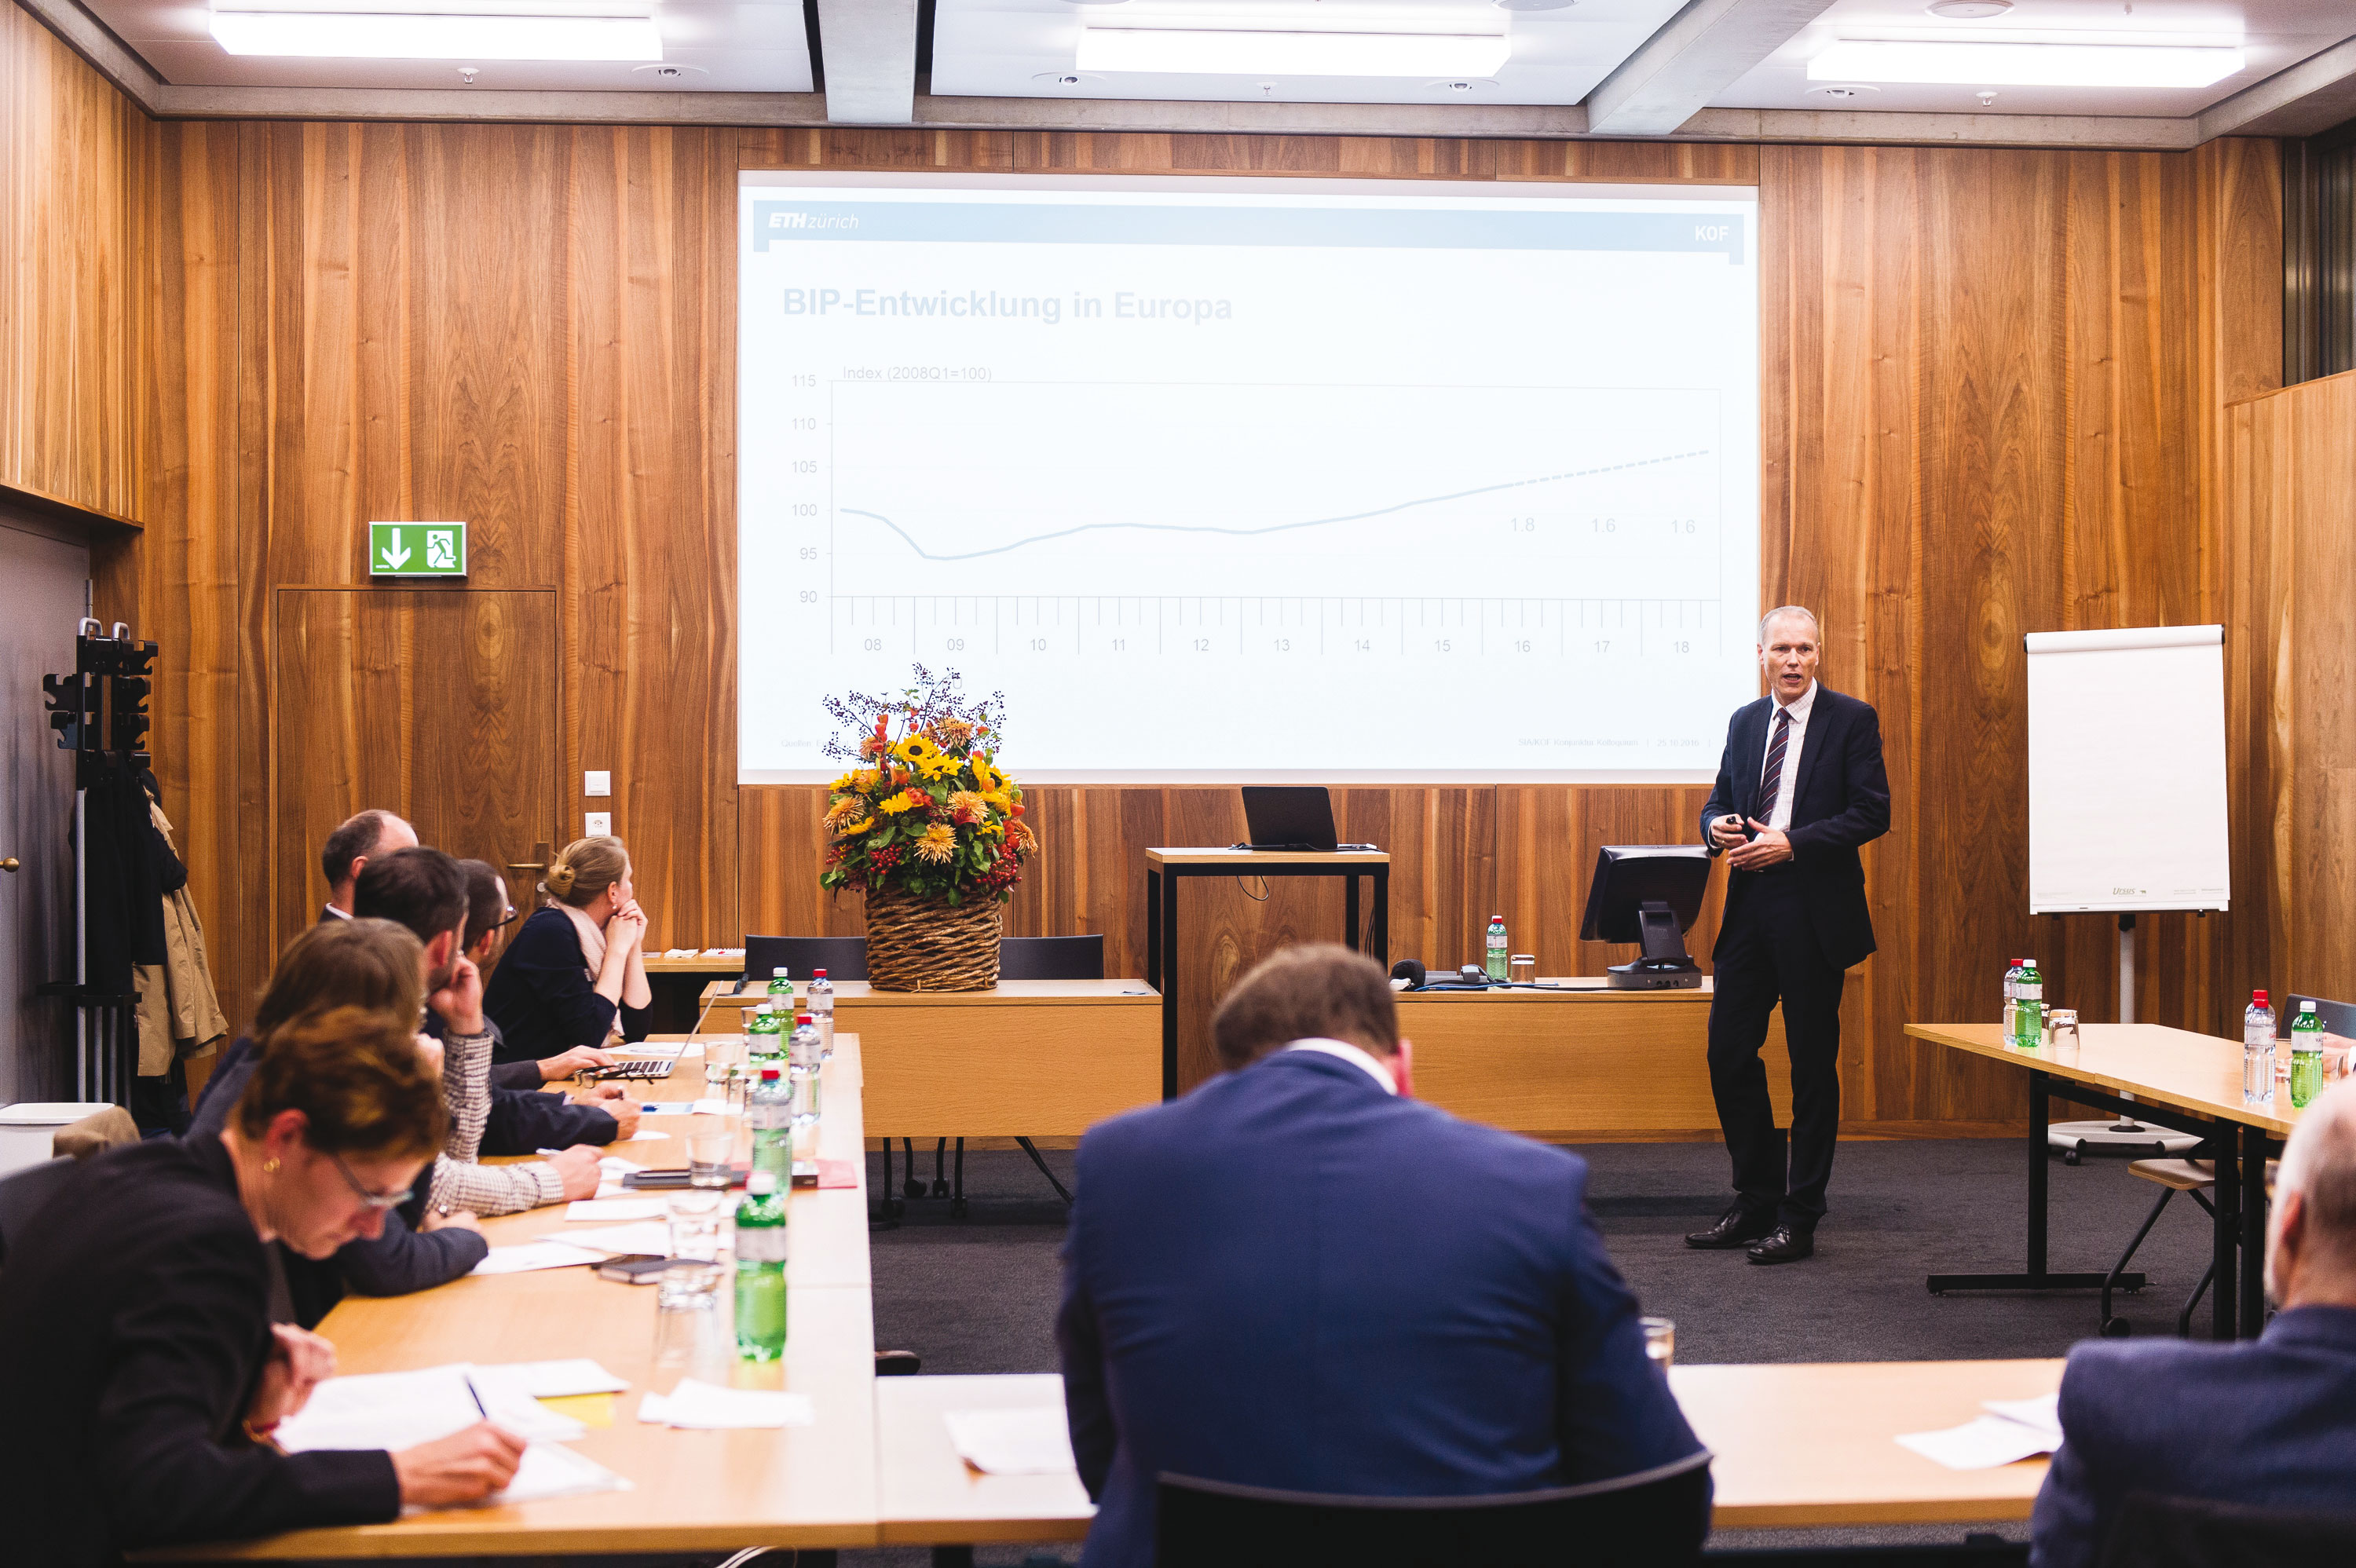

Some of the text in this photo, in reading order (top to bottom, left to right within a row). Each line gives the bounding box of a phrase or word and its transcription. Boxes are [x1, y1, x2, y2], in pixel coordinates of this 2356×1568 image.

[769, 213, 858, 228] ETH zürich
[1696, 226, 1729, 241] KOF
[784, 288, 1231, 326] BIP-Entwicklung in Europa
[792, 374, 816, 387] 115
[843, 366, 992, 382] Index (2008Q1=100)
[792, 418, 816, 430] 110
[792, 460, 817, 473] 105
[792, 503, 817, 517] 100
[1511, 517, 1696, 534] 1.8 1.6 1.6
[800, 546, 817, 561] 95
[799, 590, 817, 603] 90
[865, 638, 1689, 653] 08 09 10 11 12 13 14 15 16 17 18
